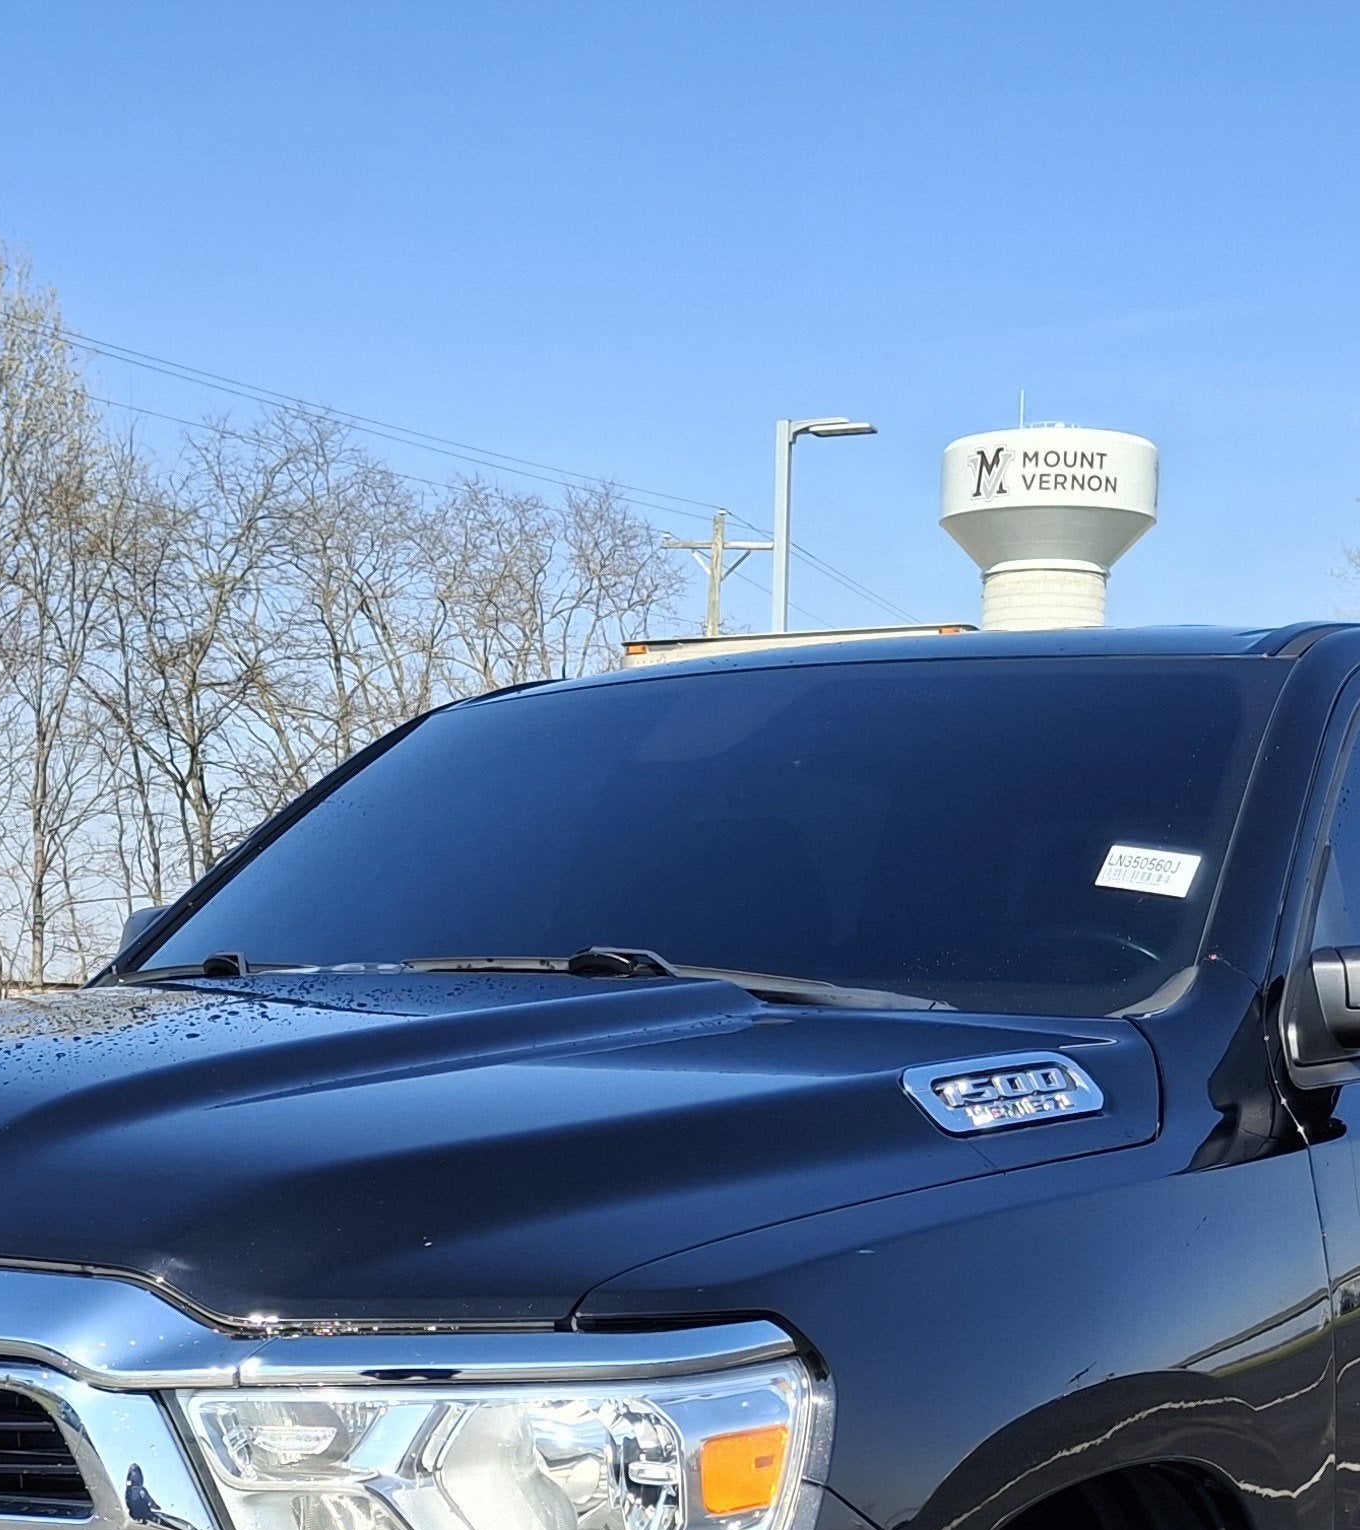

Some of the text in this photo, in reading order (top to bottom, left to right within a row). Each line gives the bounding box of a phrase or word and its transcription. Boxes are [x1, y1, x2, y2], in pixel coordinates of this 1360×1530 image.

[1022, 450, 1108, 470] MOUNT
[1021, 473, 1118, 493] VERNON
[939, 1067, 1068, 1111] 1500
